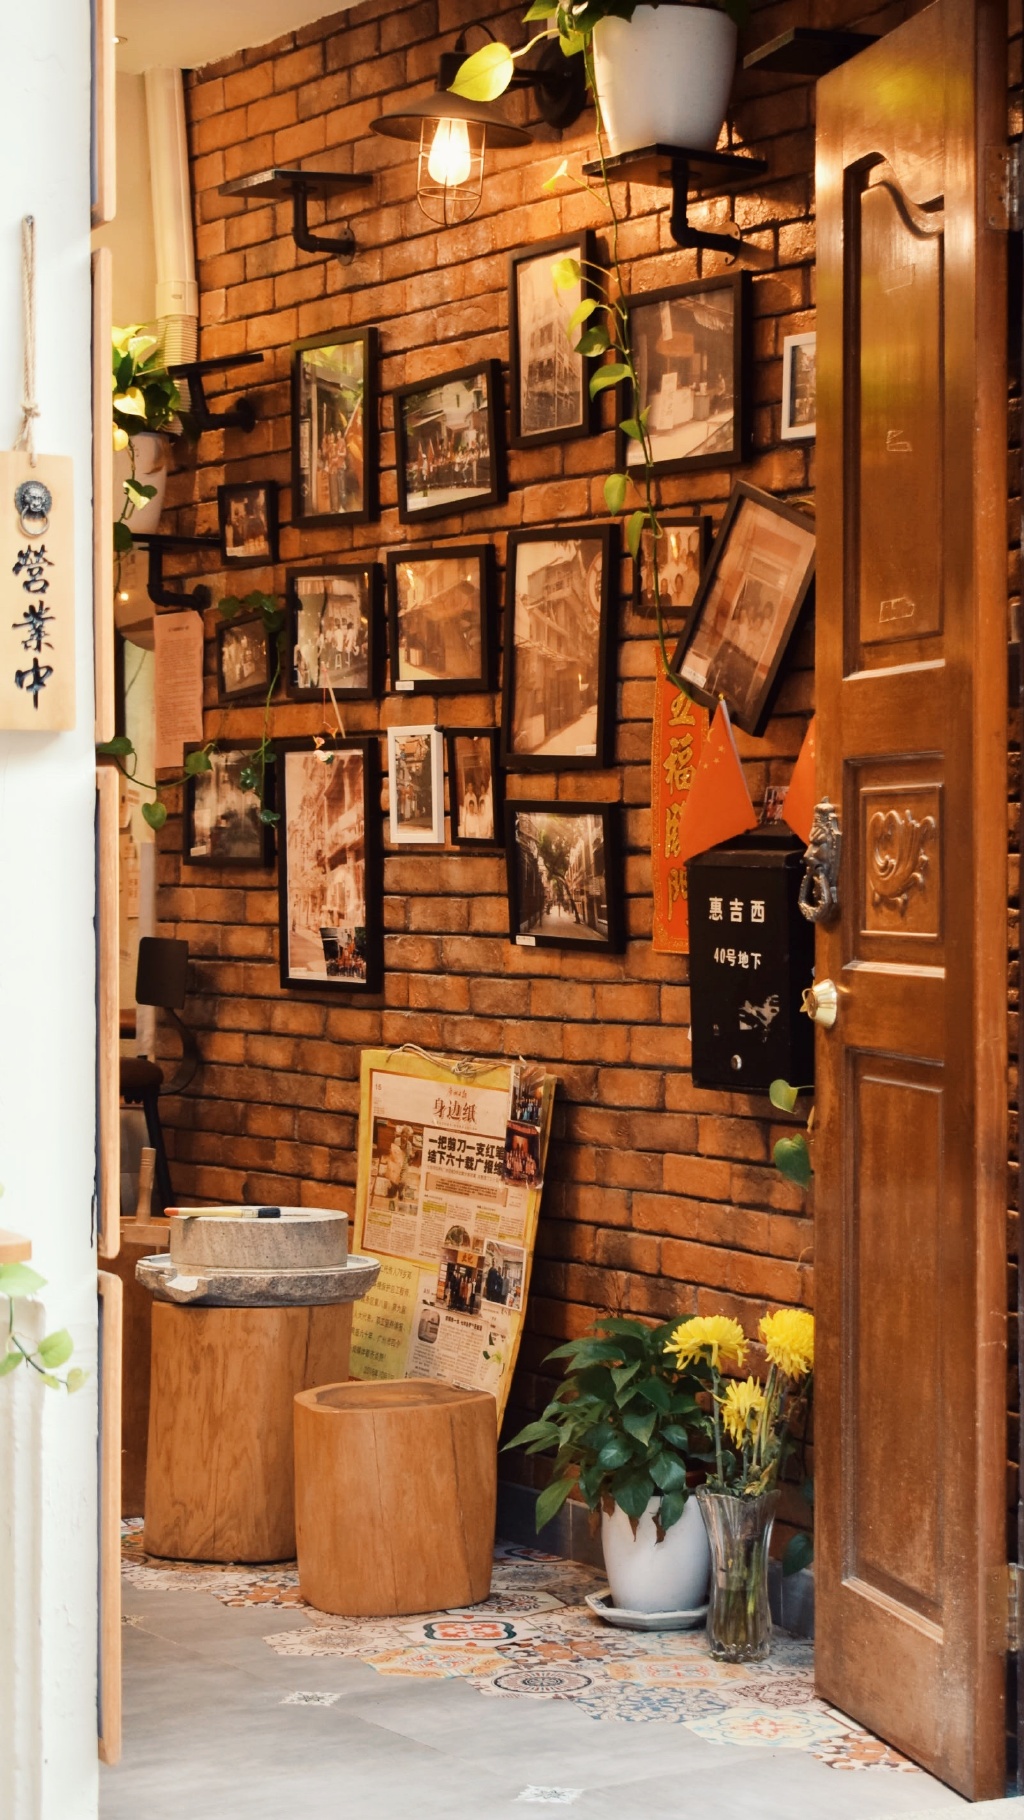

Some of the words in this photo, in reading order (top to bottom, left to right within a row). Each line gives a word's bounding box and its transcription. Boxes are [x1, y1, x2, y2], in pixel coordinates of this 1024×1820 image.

[12, 544, 55, 710] 營業中
[713, 947, 762, 970] 40号地下
[433, 1097, 478, 1125] 身边纸
